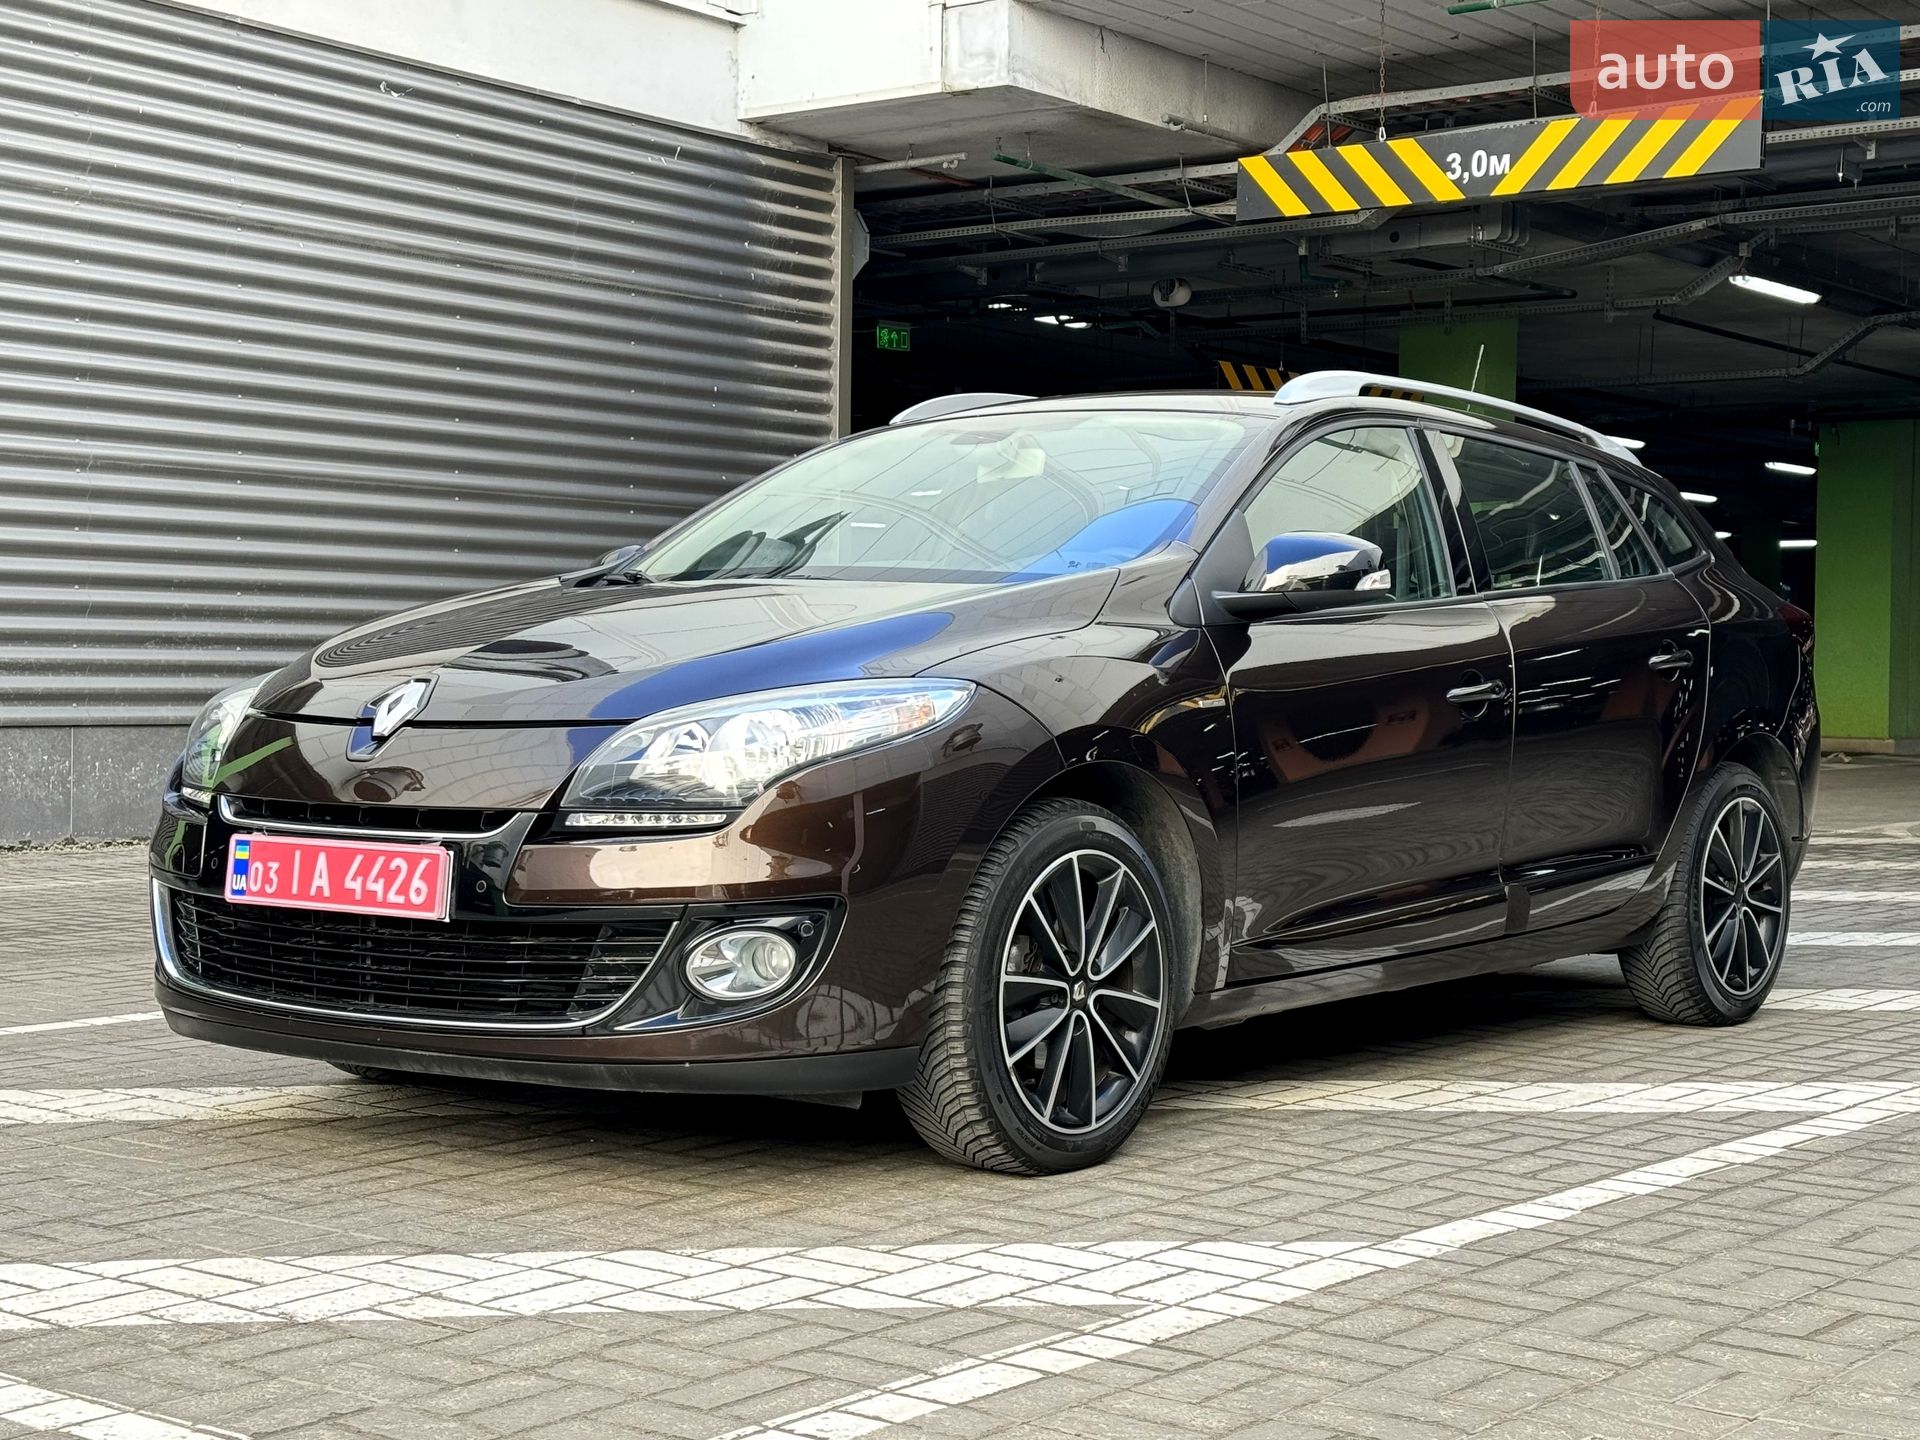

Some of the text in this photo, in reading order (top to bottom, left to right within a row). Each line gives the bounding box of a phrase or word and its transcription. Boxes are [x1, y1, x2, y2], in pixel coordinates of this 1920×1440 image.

[232, 874, 247, 891] UA
[249, 849, 433, 906] 03 IA 4426
